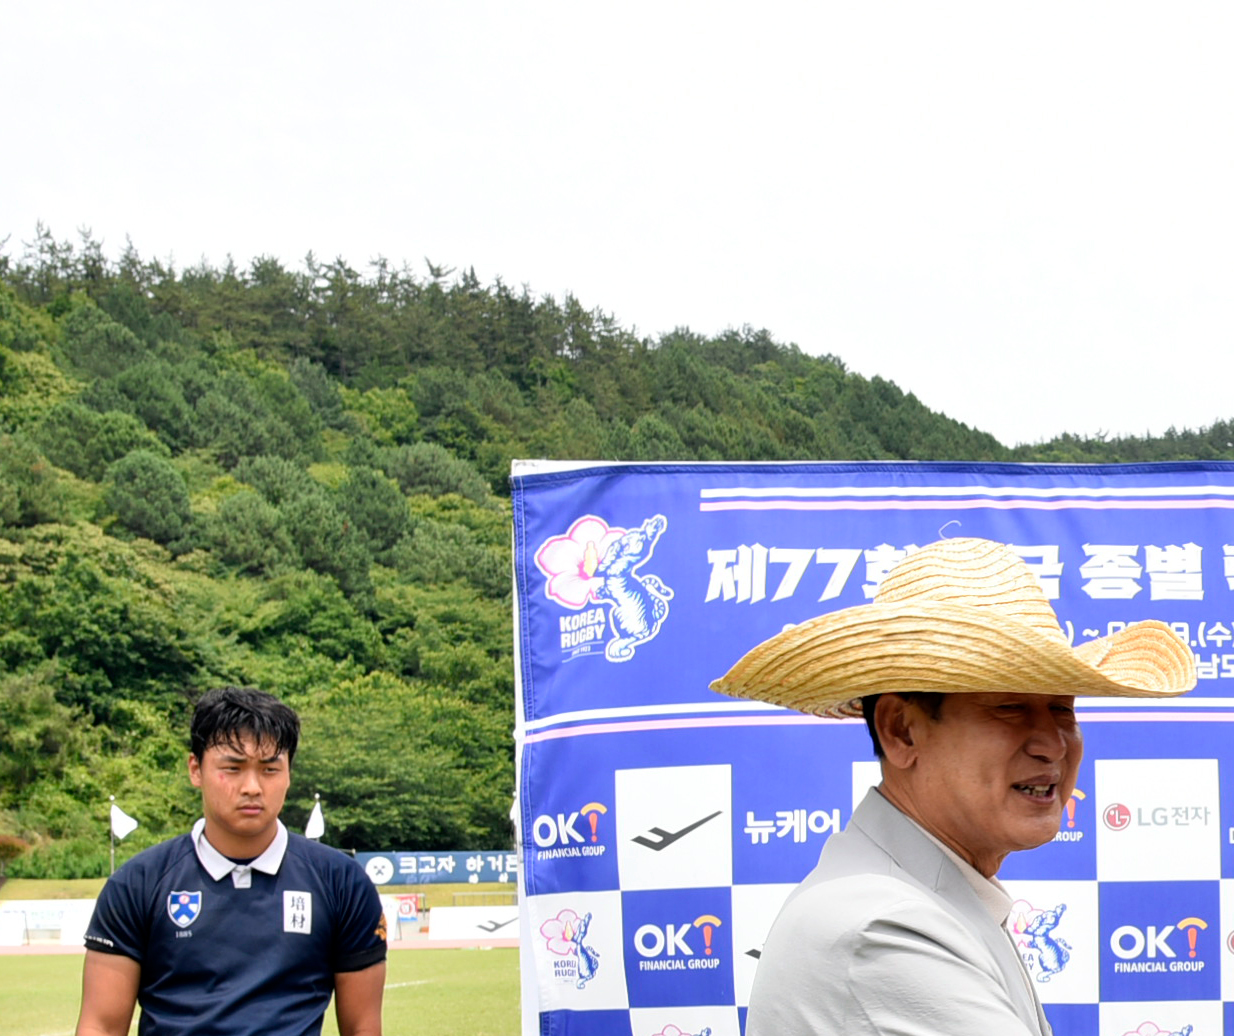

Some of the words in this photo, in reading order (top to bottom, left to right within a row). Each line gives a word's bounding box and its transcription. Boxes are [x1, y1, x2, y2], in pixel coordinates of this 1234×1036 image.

[1079, 541, 1205, 601] 종별
[560, 607, 606, 633] KOREA
[560, 624, 606, 649] RUGBY
[744, 809, 841, 845] 뉴케어
[1137, 806, 1211, 827] LG전자
[537, 847, 581, 861] FINANCIAL
[582, 844, 606, 858] GROUP
[399, 854, 456, 875] 크고자
[639, 958, 686, 971] FINANCIAL
[688, 957, 720, 970] GROUP
[1114, 961, 1168, 973] FINANCIAL
[1169, 960, 1205, 973] GROUP
